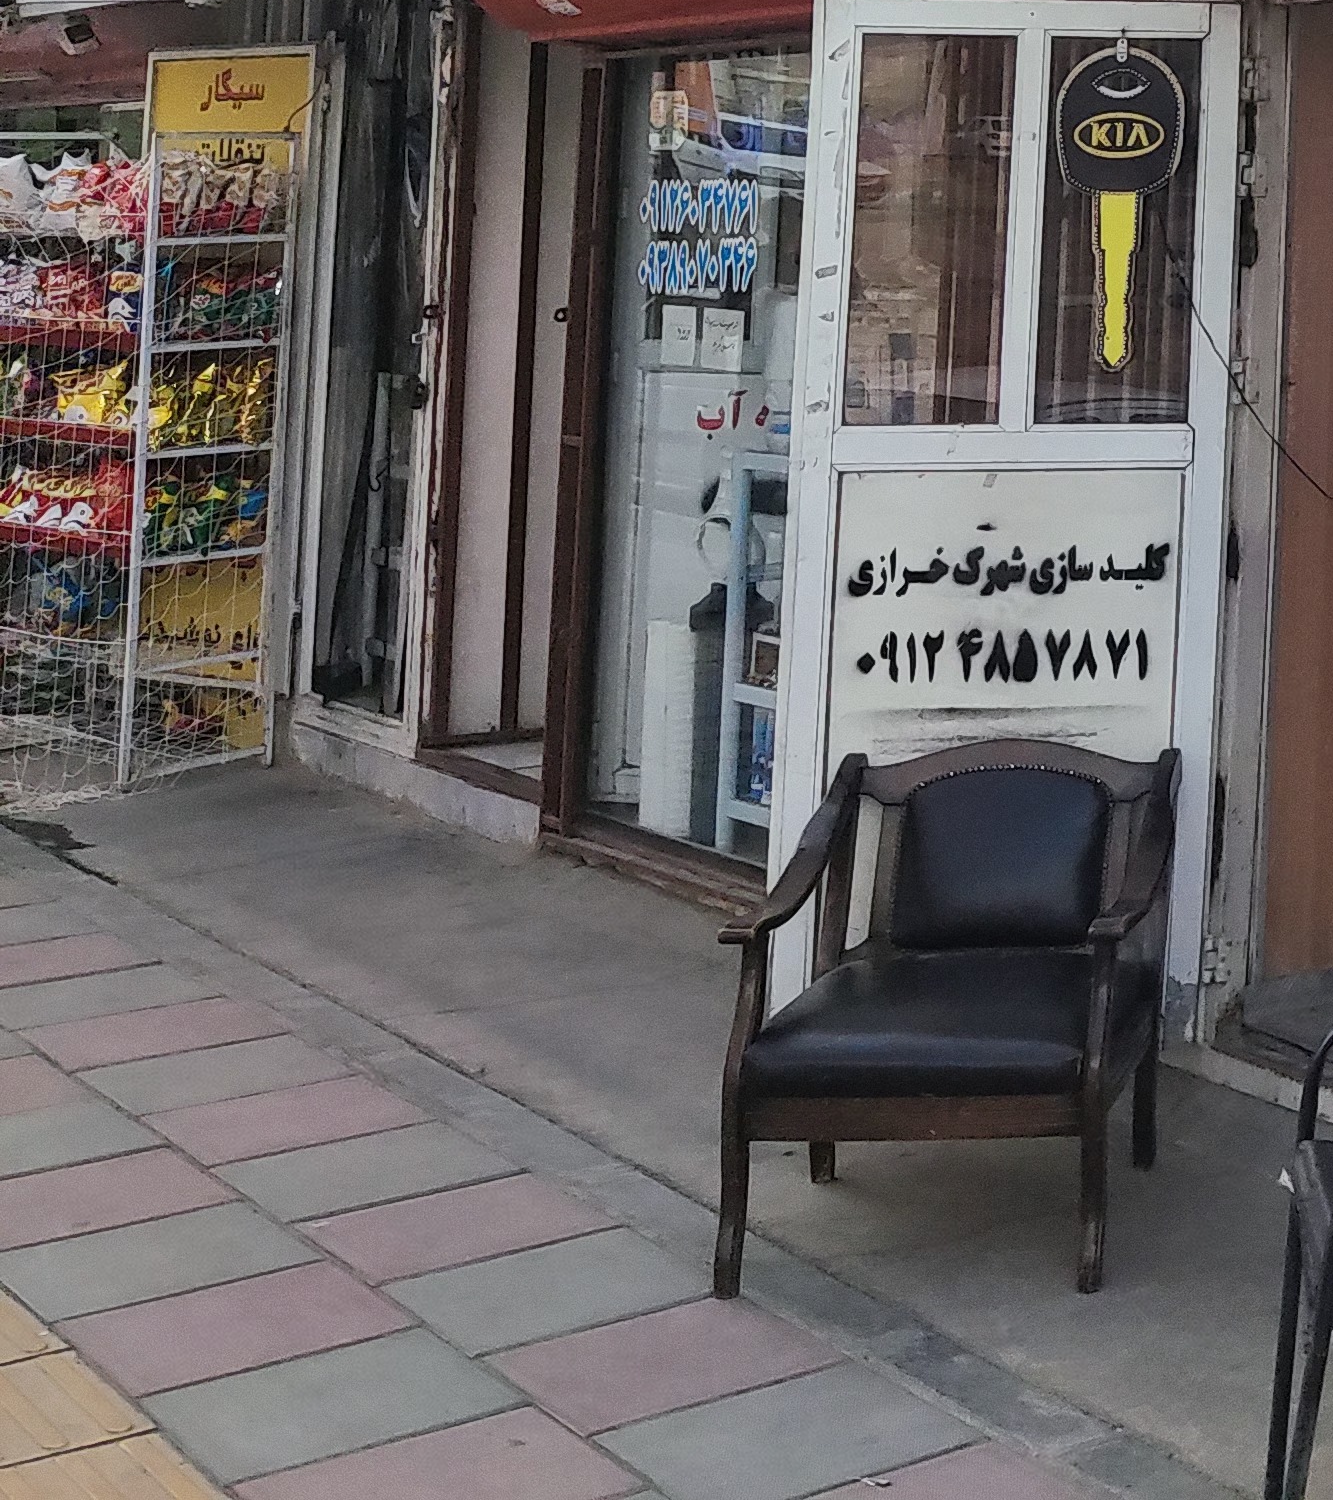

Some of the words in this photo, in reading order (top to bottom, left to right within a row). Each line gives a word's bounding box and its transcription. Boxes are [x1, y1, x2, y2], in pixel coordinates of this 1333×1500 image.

[1089, 121, 1149, 148] KIA
[848, 546, 951, 598] خرازی
[1029, 544, 1094, 595] سازی
[1099, 542, 1171, 591] کلید
